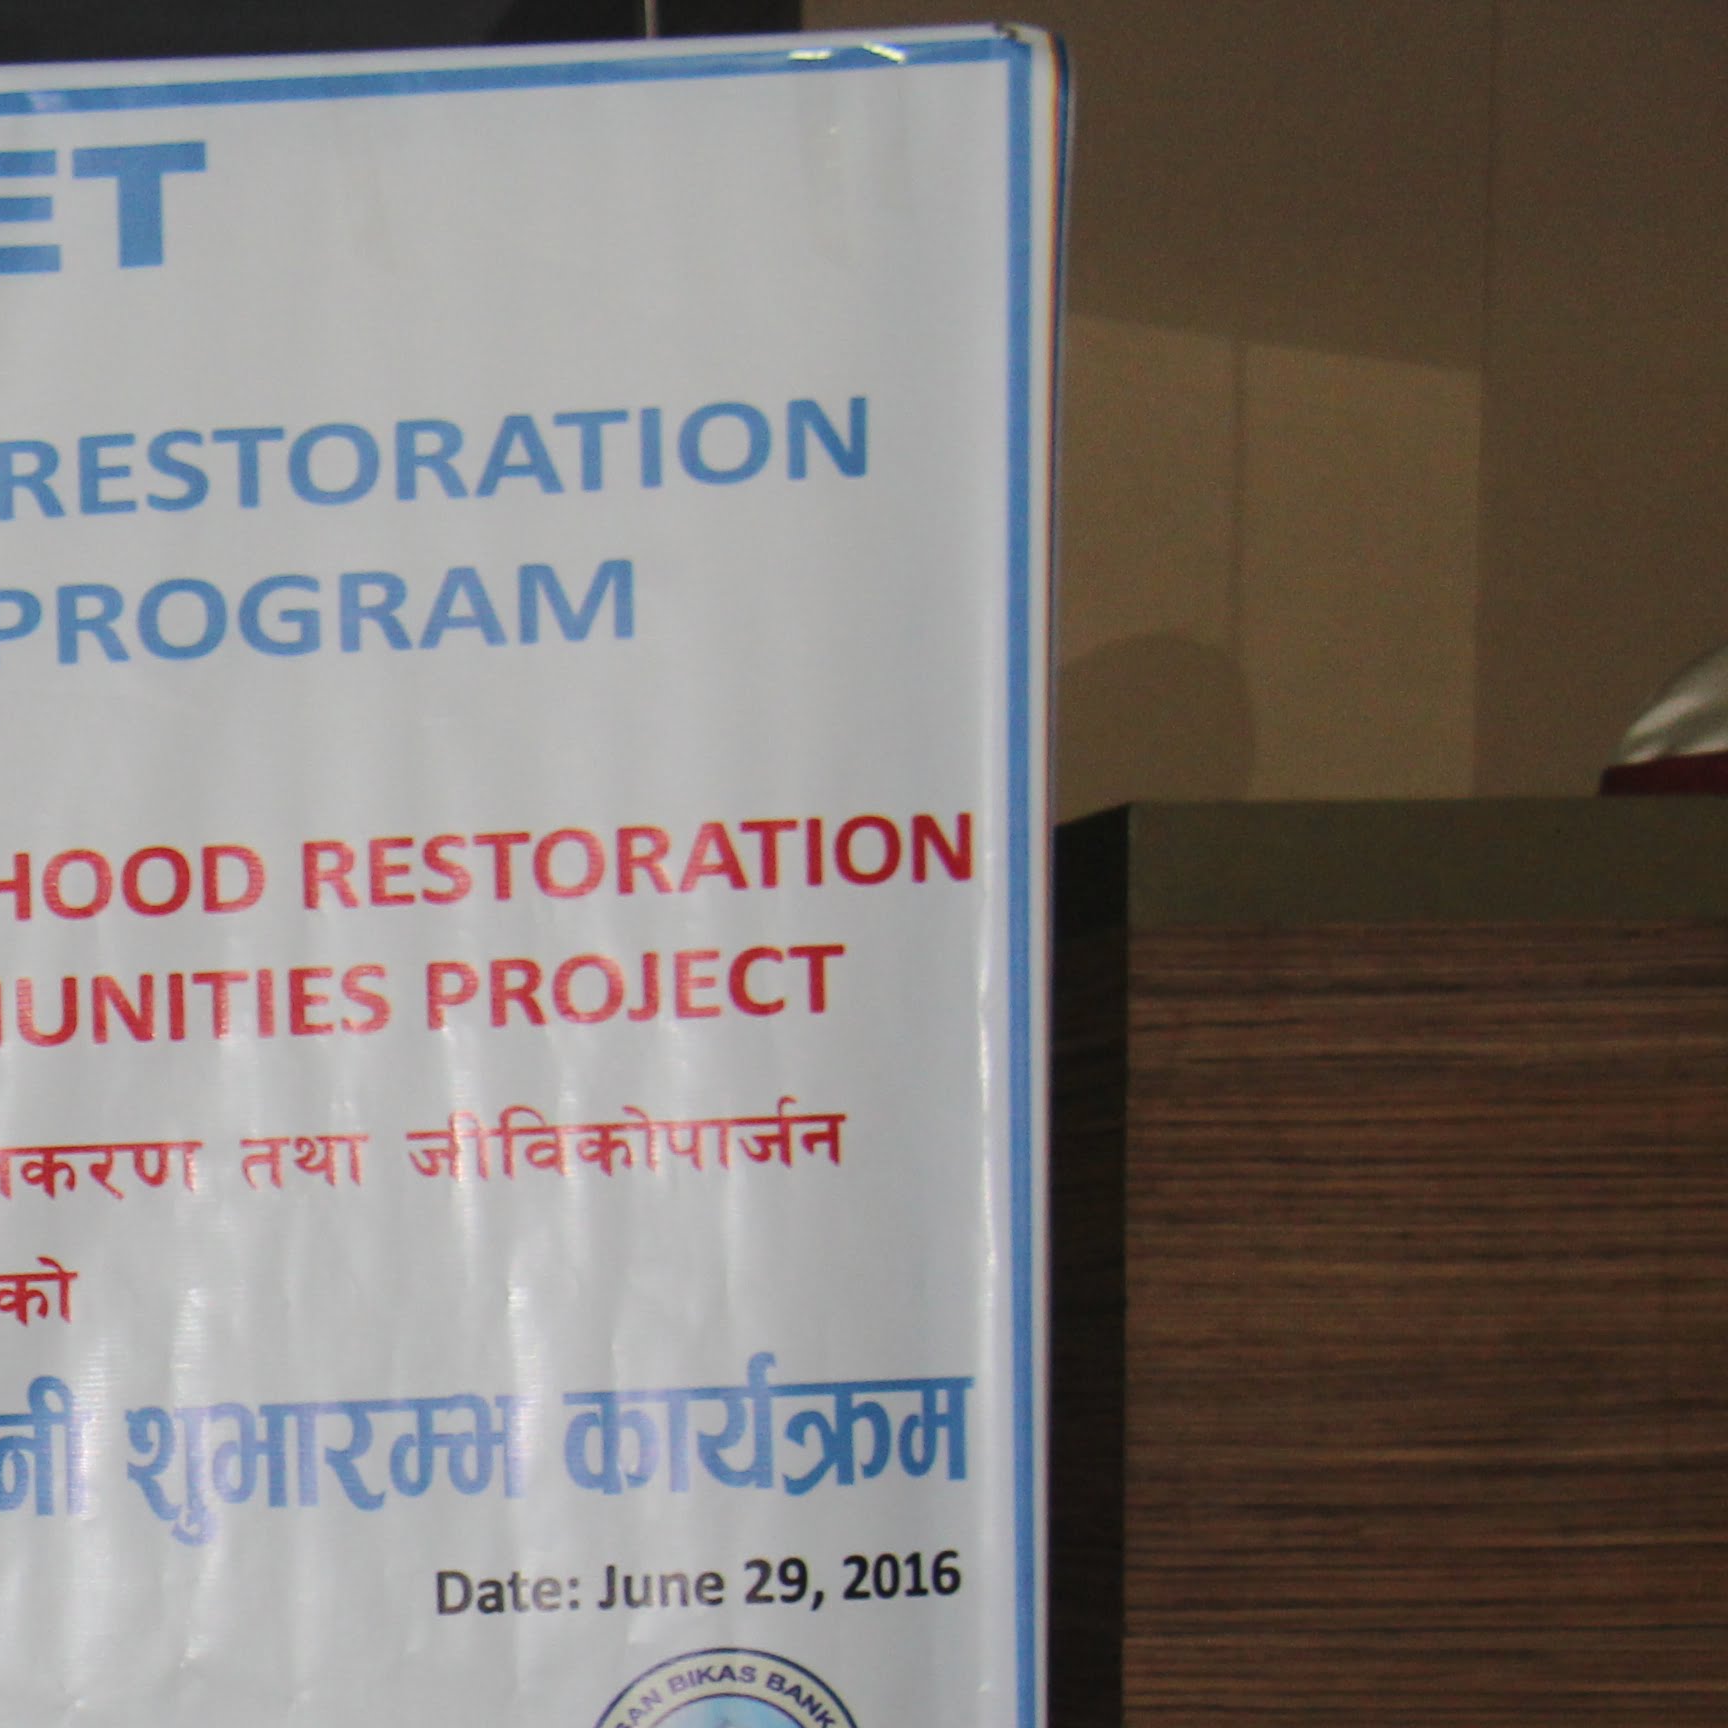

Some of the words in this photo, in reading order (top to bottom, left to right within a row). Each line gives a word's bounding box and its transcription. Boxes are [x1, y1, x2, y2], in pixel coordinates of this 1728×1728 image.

[302, 811, 977, 909] RESTORATION
[426, 942, 847, 1030] PROJECT
[240, 1134, 369, 1189] तथा
[406, 1097, 847, 1180] जीविकोपार्जन
[124, 1394, 524, 1547] शुभारम्भ
[562, 1352, 975, 1496] कार्यक्रम
[434, 1570, 584, 1617] Date:
[597, 1562, 725, 1612] June
[743, 1557, 827, 1612] 29,
[841, 1549, 962, 1600] 2016
[668, 1664, 757, 1696] BIKAS
